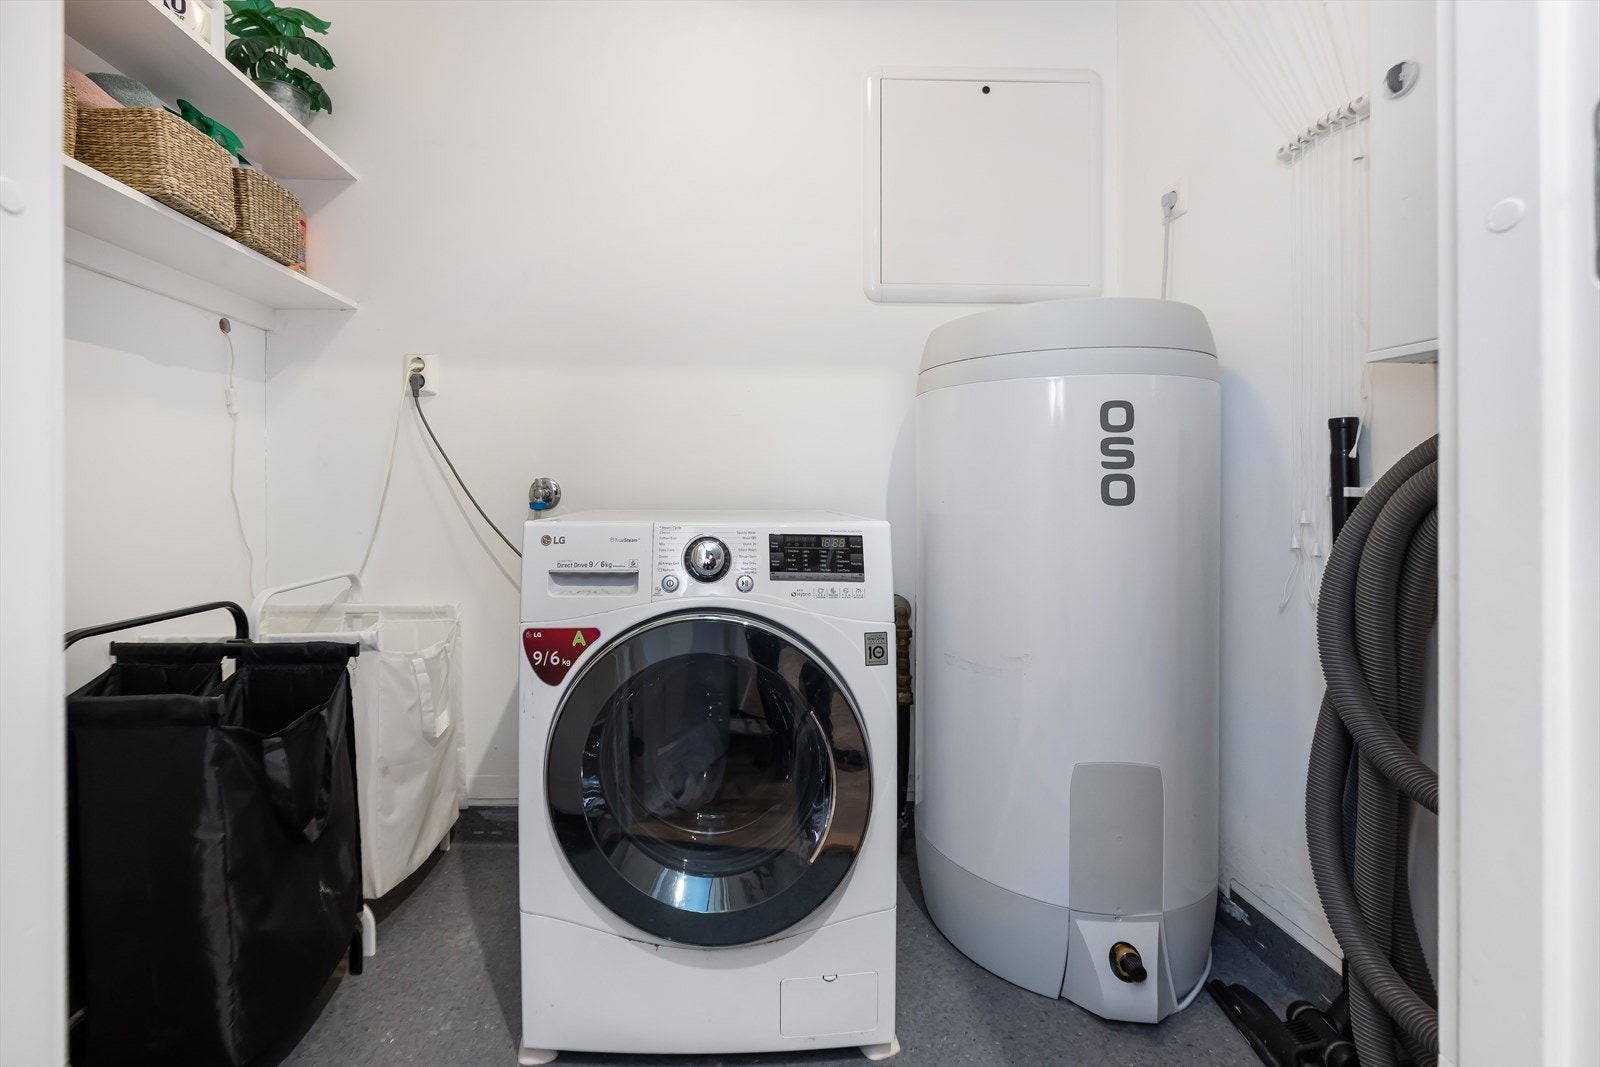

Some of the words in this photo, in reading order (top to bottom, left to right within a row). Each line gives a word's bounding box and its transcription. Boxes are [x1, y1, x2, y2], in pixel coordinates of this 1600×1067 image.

[1099, 399, 1136, 507] OSO
[553, 536, 566, 545] LG
[572, 630, 587, 646] A
[532, 650, 560, 666] 9/6
[561, 658, 571, 666] kg
